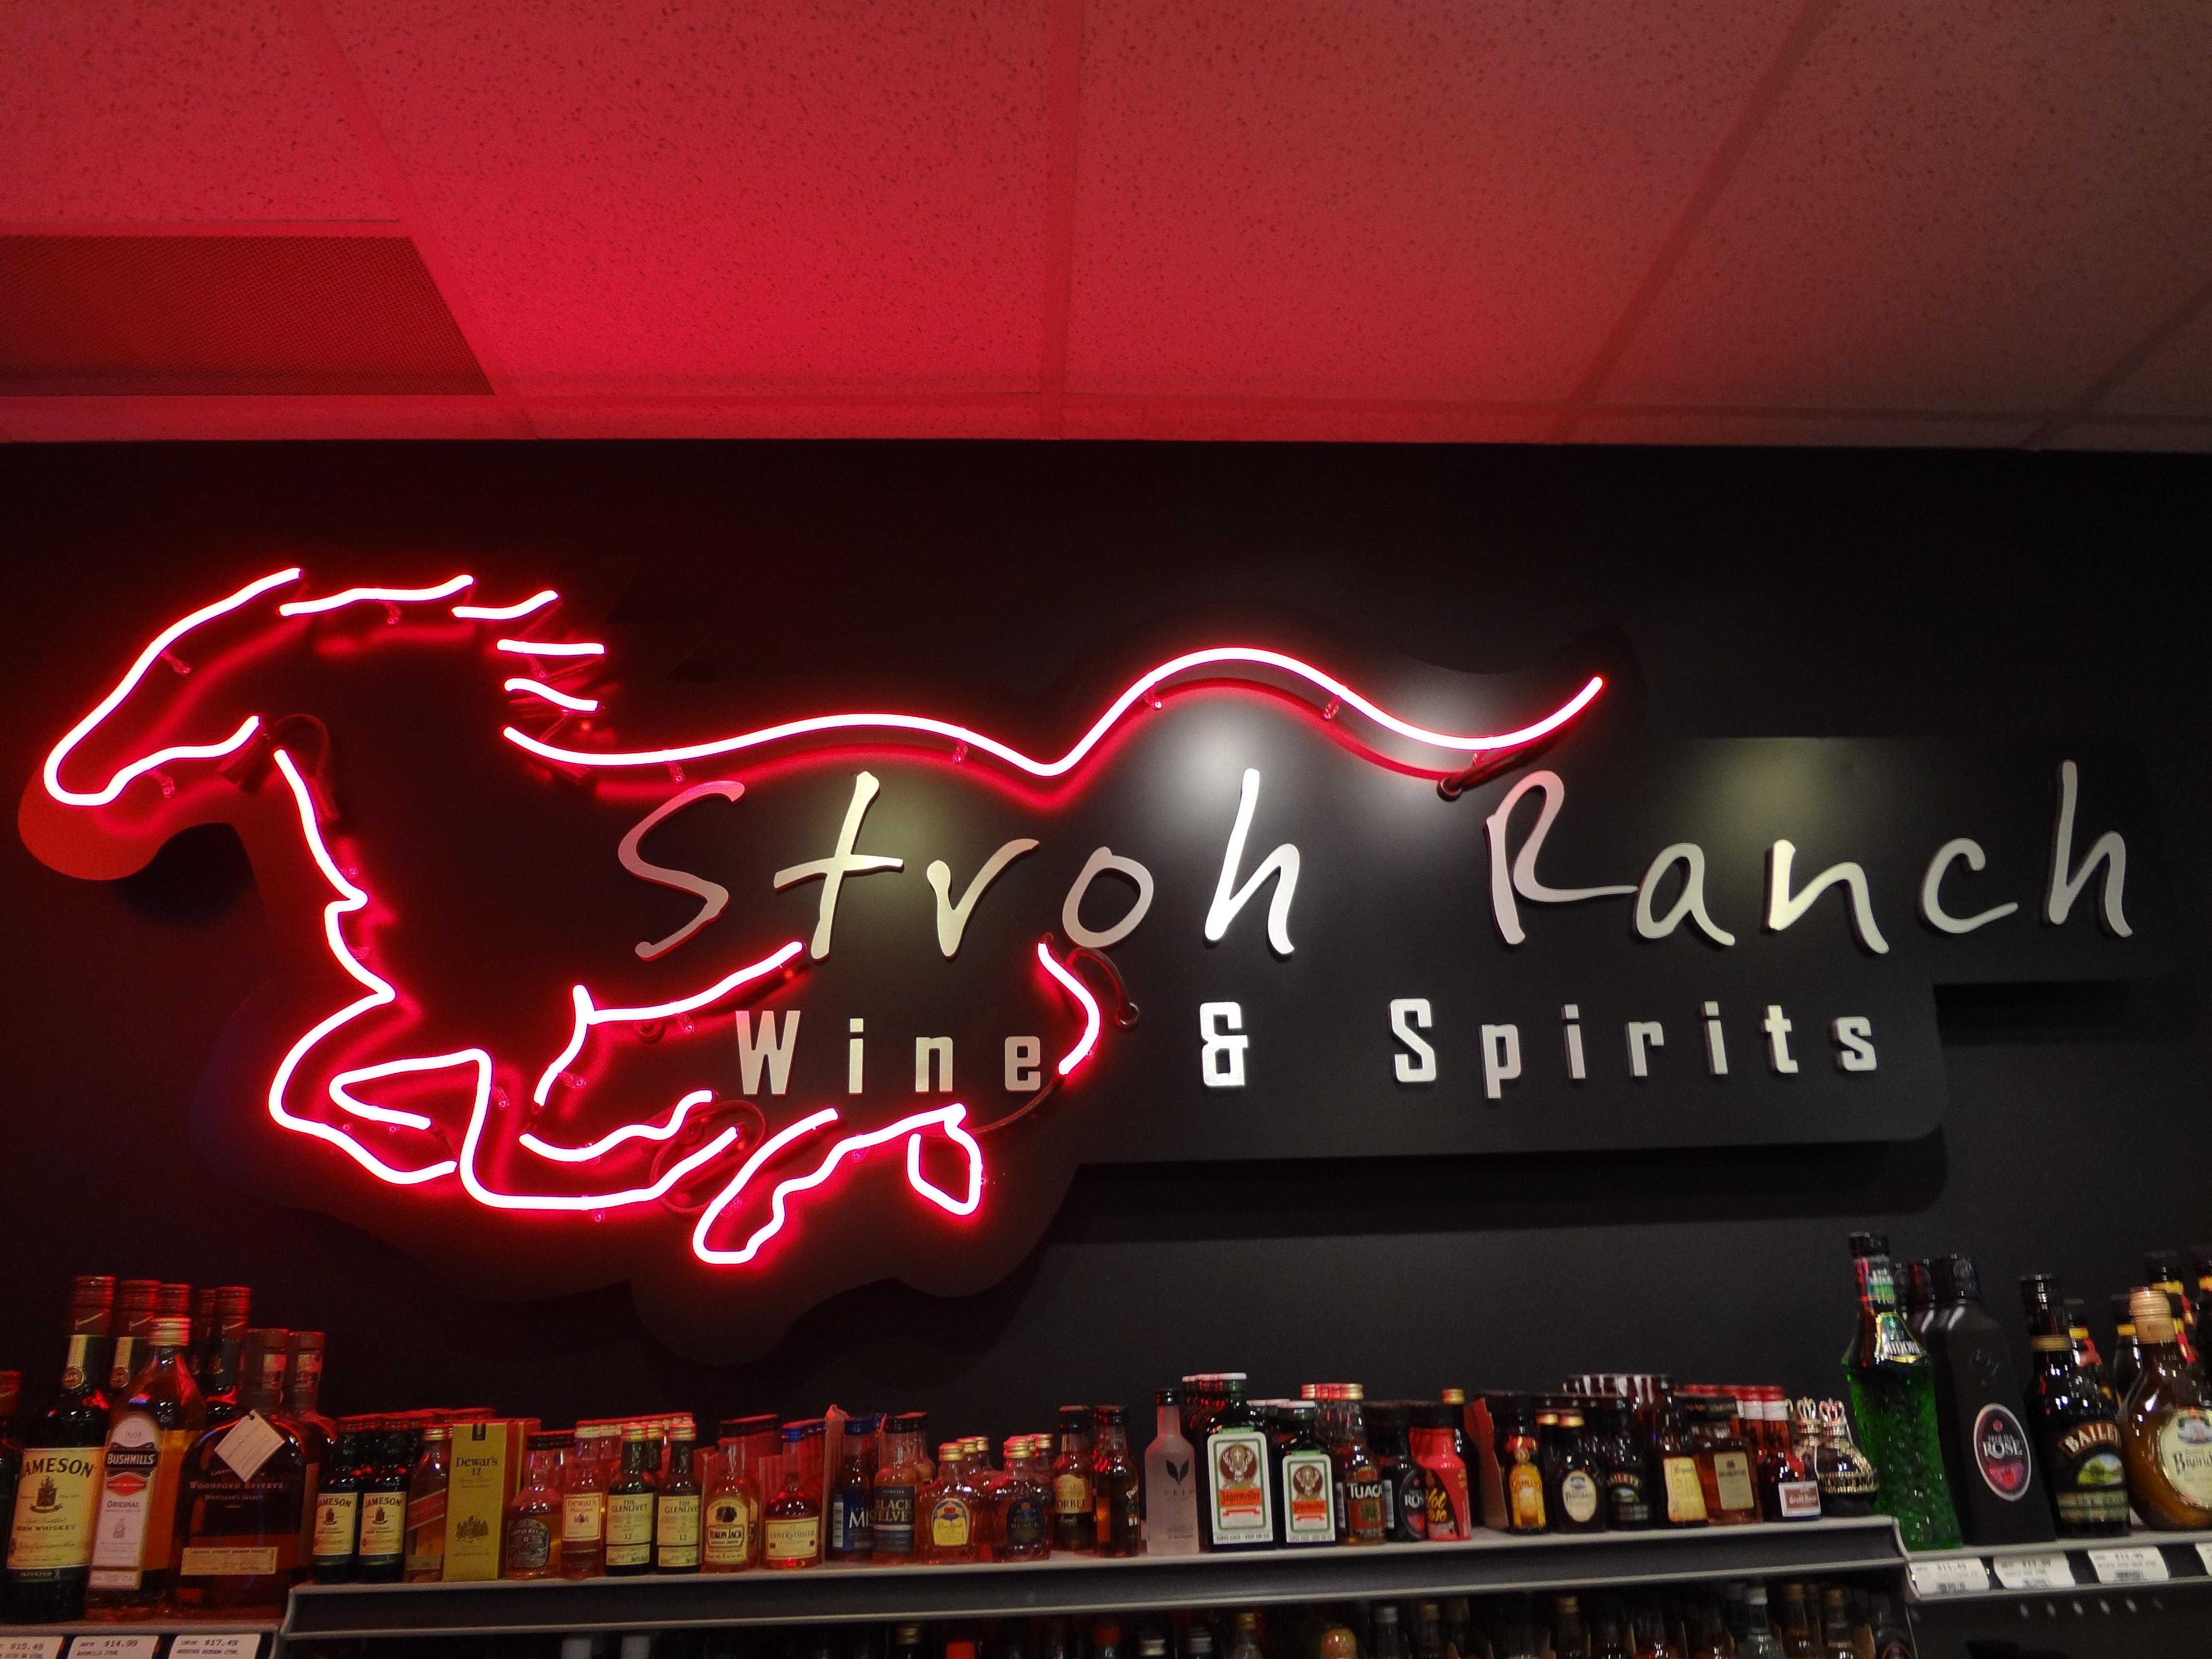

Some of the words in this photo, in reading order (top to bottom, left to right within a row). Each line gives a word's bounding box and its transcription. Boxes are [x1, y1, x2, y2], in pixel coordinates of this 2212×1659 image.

[617, 767, 1301, 960] Stroh
[1485, 759, 2133, 955] Ranch
[734, 1010, 1042, 1097] Wine
[1199, 1001, 1249, 1089] &
[1388, 997, 1878, 1099] Spirits
[2064, 1421, 2118, 1453] BAILE
[1983, 1439, 2023, 1459] ROSE
[107, 1453, 155, 1465] BUSHMILLS
[457, 1457, 498, 1467] Dewar's
[471, 1467, 481, 1476] 12
[189, 1480, 240, 1489] WOODFORD
[107, 1500, 139, 1508] ORIGINAL
[364, 1496, 401, 1508] JAMESON
[875, 1499, 912, 1510] BLACK
[611, 1503, 648, 1513] GLENLIVET
[664, 1505, 698, 1514] GLENLIVE
[104, 1639, 139, 1647] $14.99
